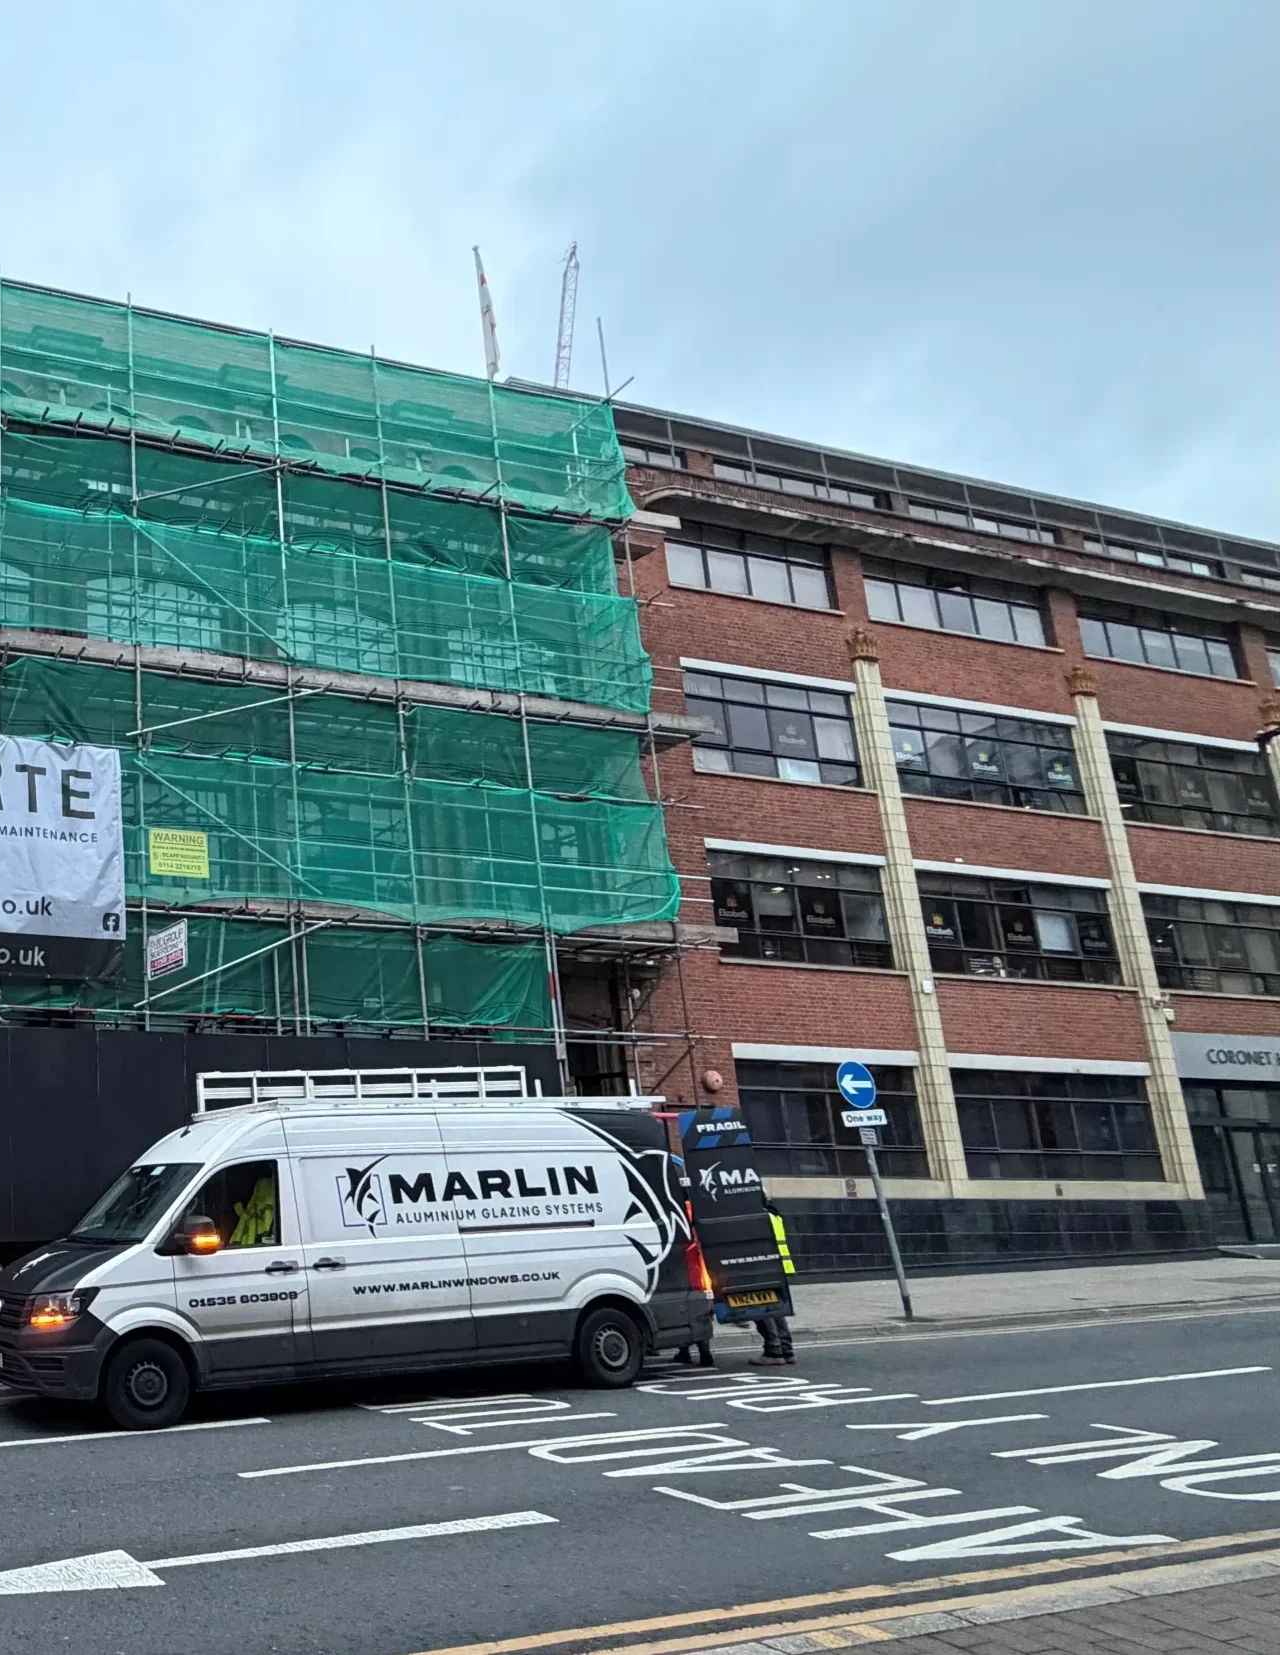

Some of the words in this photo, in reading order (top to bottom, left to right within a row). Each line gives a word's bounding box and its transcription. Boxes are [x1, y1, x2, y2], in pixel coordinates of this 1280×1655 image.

[153, 832, 205, 845] WARNING
[1205, 1048, 1272, 1066] CORONET
[696, 1121, 746, 1133] FRAGIL
[846, 1114, 864, 1123] One
[867, 1114, 883, 1122] way
[388, 1165, 599, 1204] MARLIN
[396, 1207, 477, 1224] ALUMINIUM
[481, 1204, 540, 1219] GLAZING
[545, 1202, 604, 1215] SYSTEMS
[353, 1271, 561, 1295] WWW.MARLINWINDOWS.CO.UK
[188, 1296, 237, 1308] 01535
[632, 1362, 918, 1413] RIGH
[845, 1413, 1280, 1502] ONLY
[529, 1431, 1180, 1562] AHEAD
